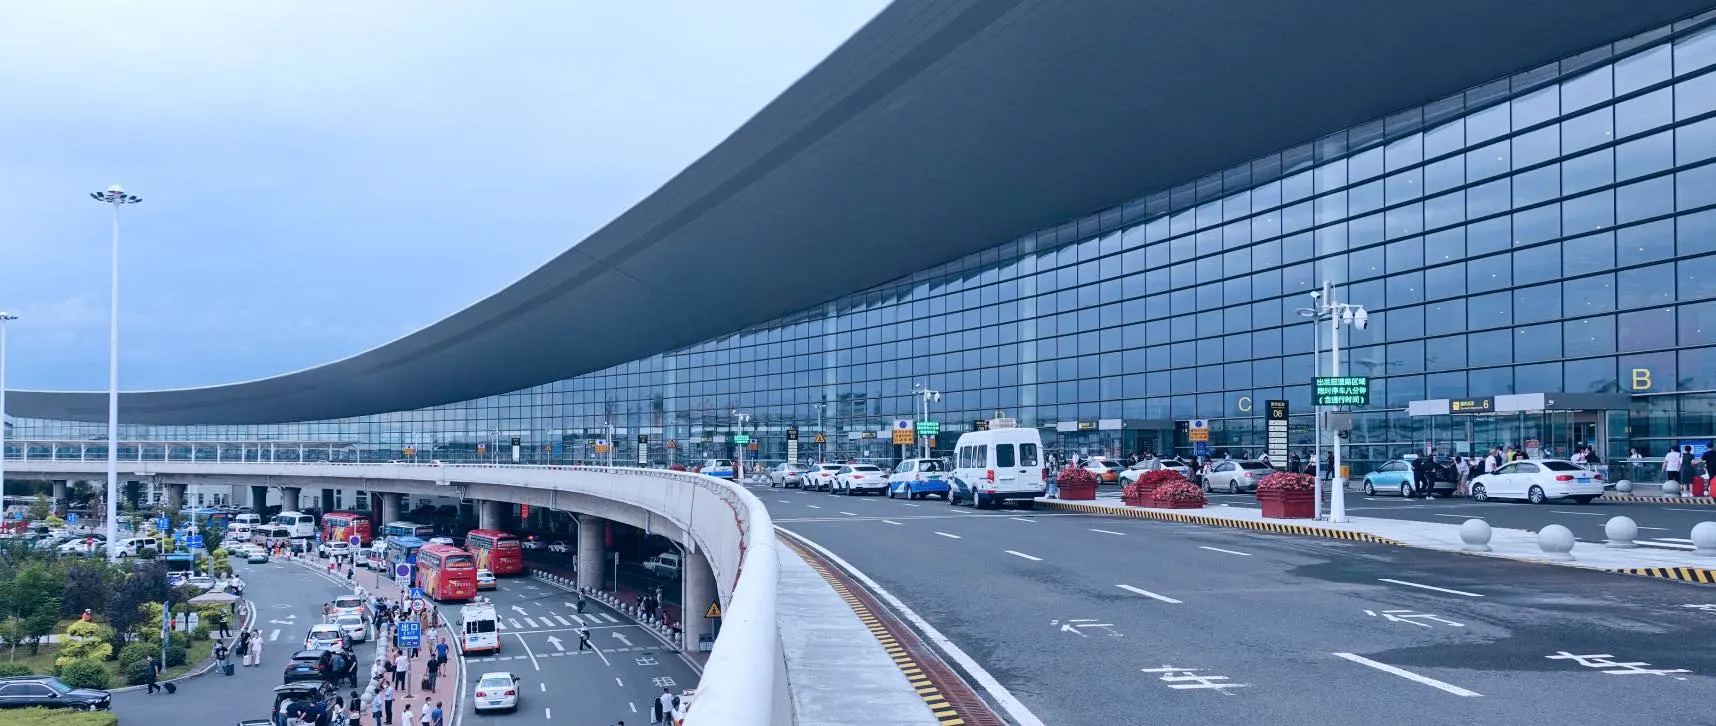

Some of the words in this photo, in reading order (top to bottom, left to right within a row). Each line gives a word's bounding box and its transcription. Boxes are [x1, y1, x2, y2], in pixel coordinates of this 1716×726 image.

[1632, 368, 1651, 390] B
[1238, 396, 1252, 412] C
[1483, 399, 1489, 409] 6
[1273, 409, 1283, 418] 06
[401, 623, 418, 631] 出口
